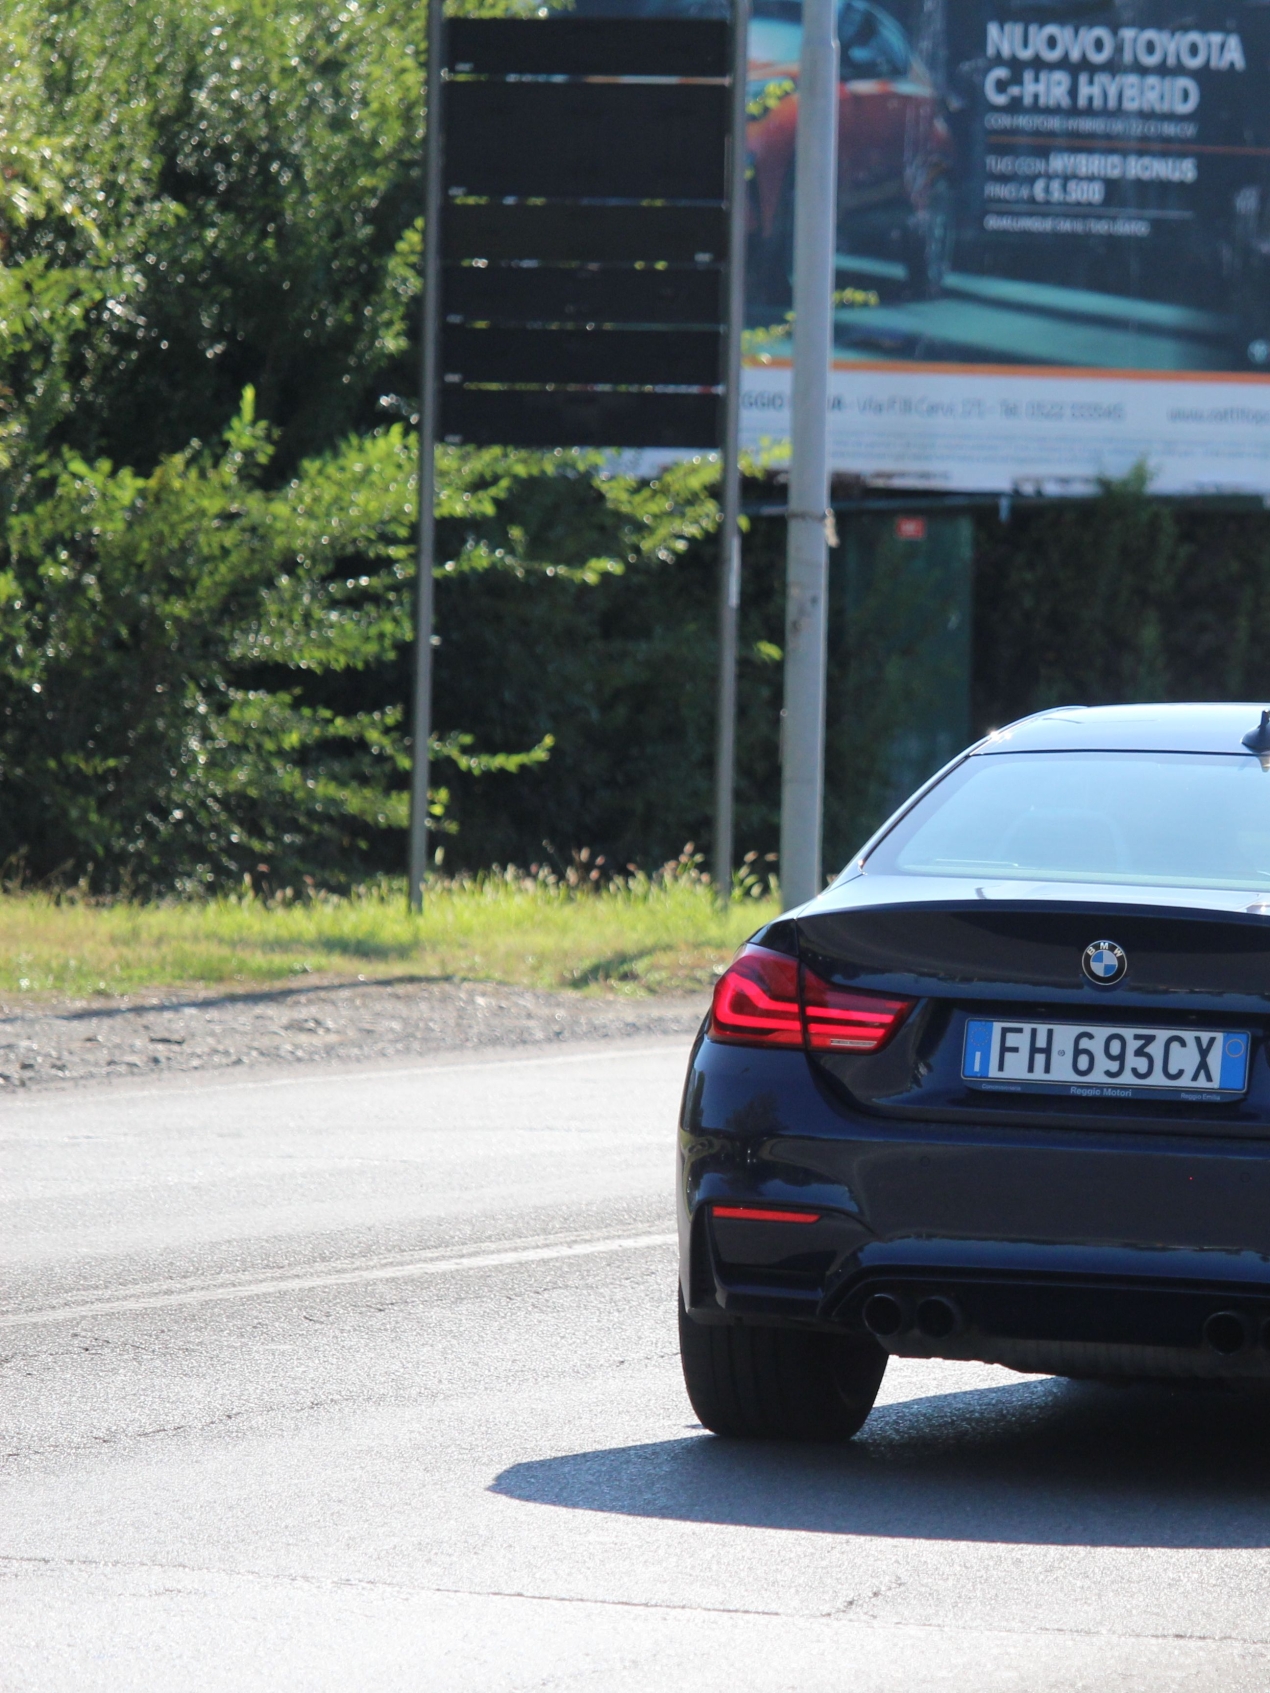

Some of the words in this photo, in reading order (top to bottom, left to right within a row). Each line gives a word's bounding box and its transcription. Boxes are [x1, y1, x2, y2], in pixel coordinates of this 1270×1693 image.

[986, 20, 1115, 64] NUOVO
[1118, 27, 1246, 72] TOYOTA
[984, 66, 1071, 108] C-HR
[1077, 71, 1200, 115] HYBRID
[1048, 152, 1123, 179] HYBRID
[1125, 155, 1197, 183] BONUS
[1086, 942, 1123, 957] BMW
[997, 1026, 1054, 1074] FH
[1070, 1030, 1217, 1083] 693CX
[1070, 1086, 1101, 1098] Reggio
[1103, 1088, 1132, 1098] Motori
[1180, 1092, 1202, 1101] Reggio
[1203, 1093, 1221, 1101] Emilia
